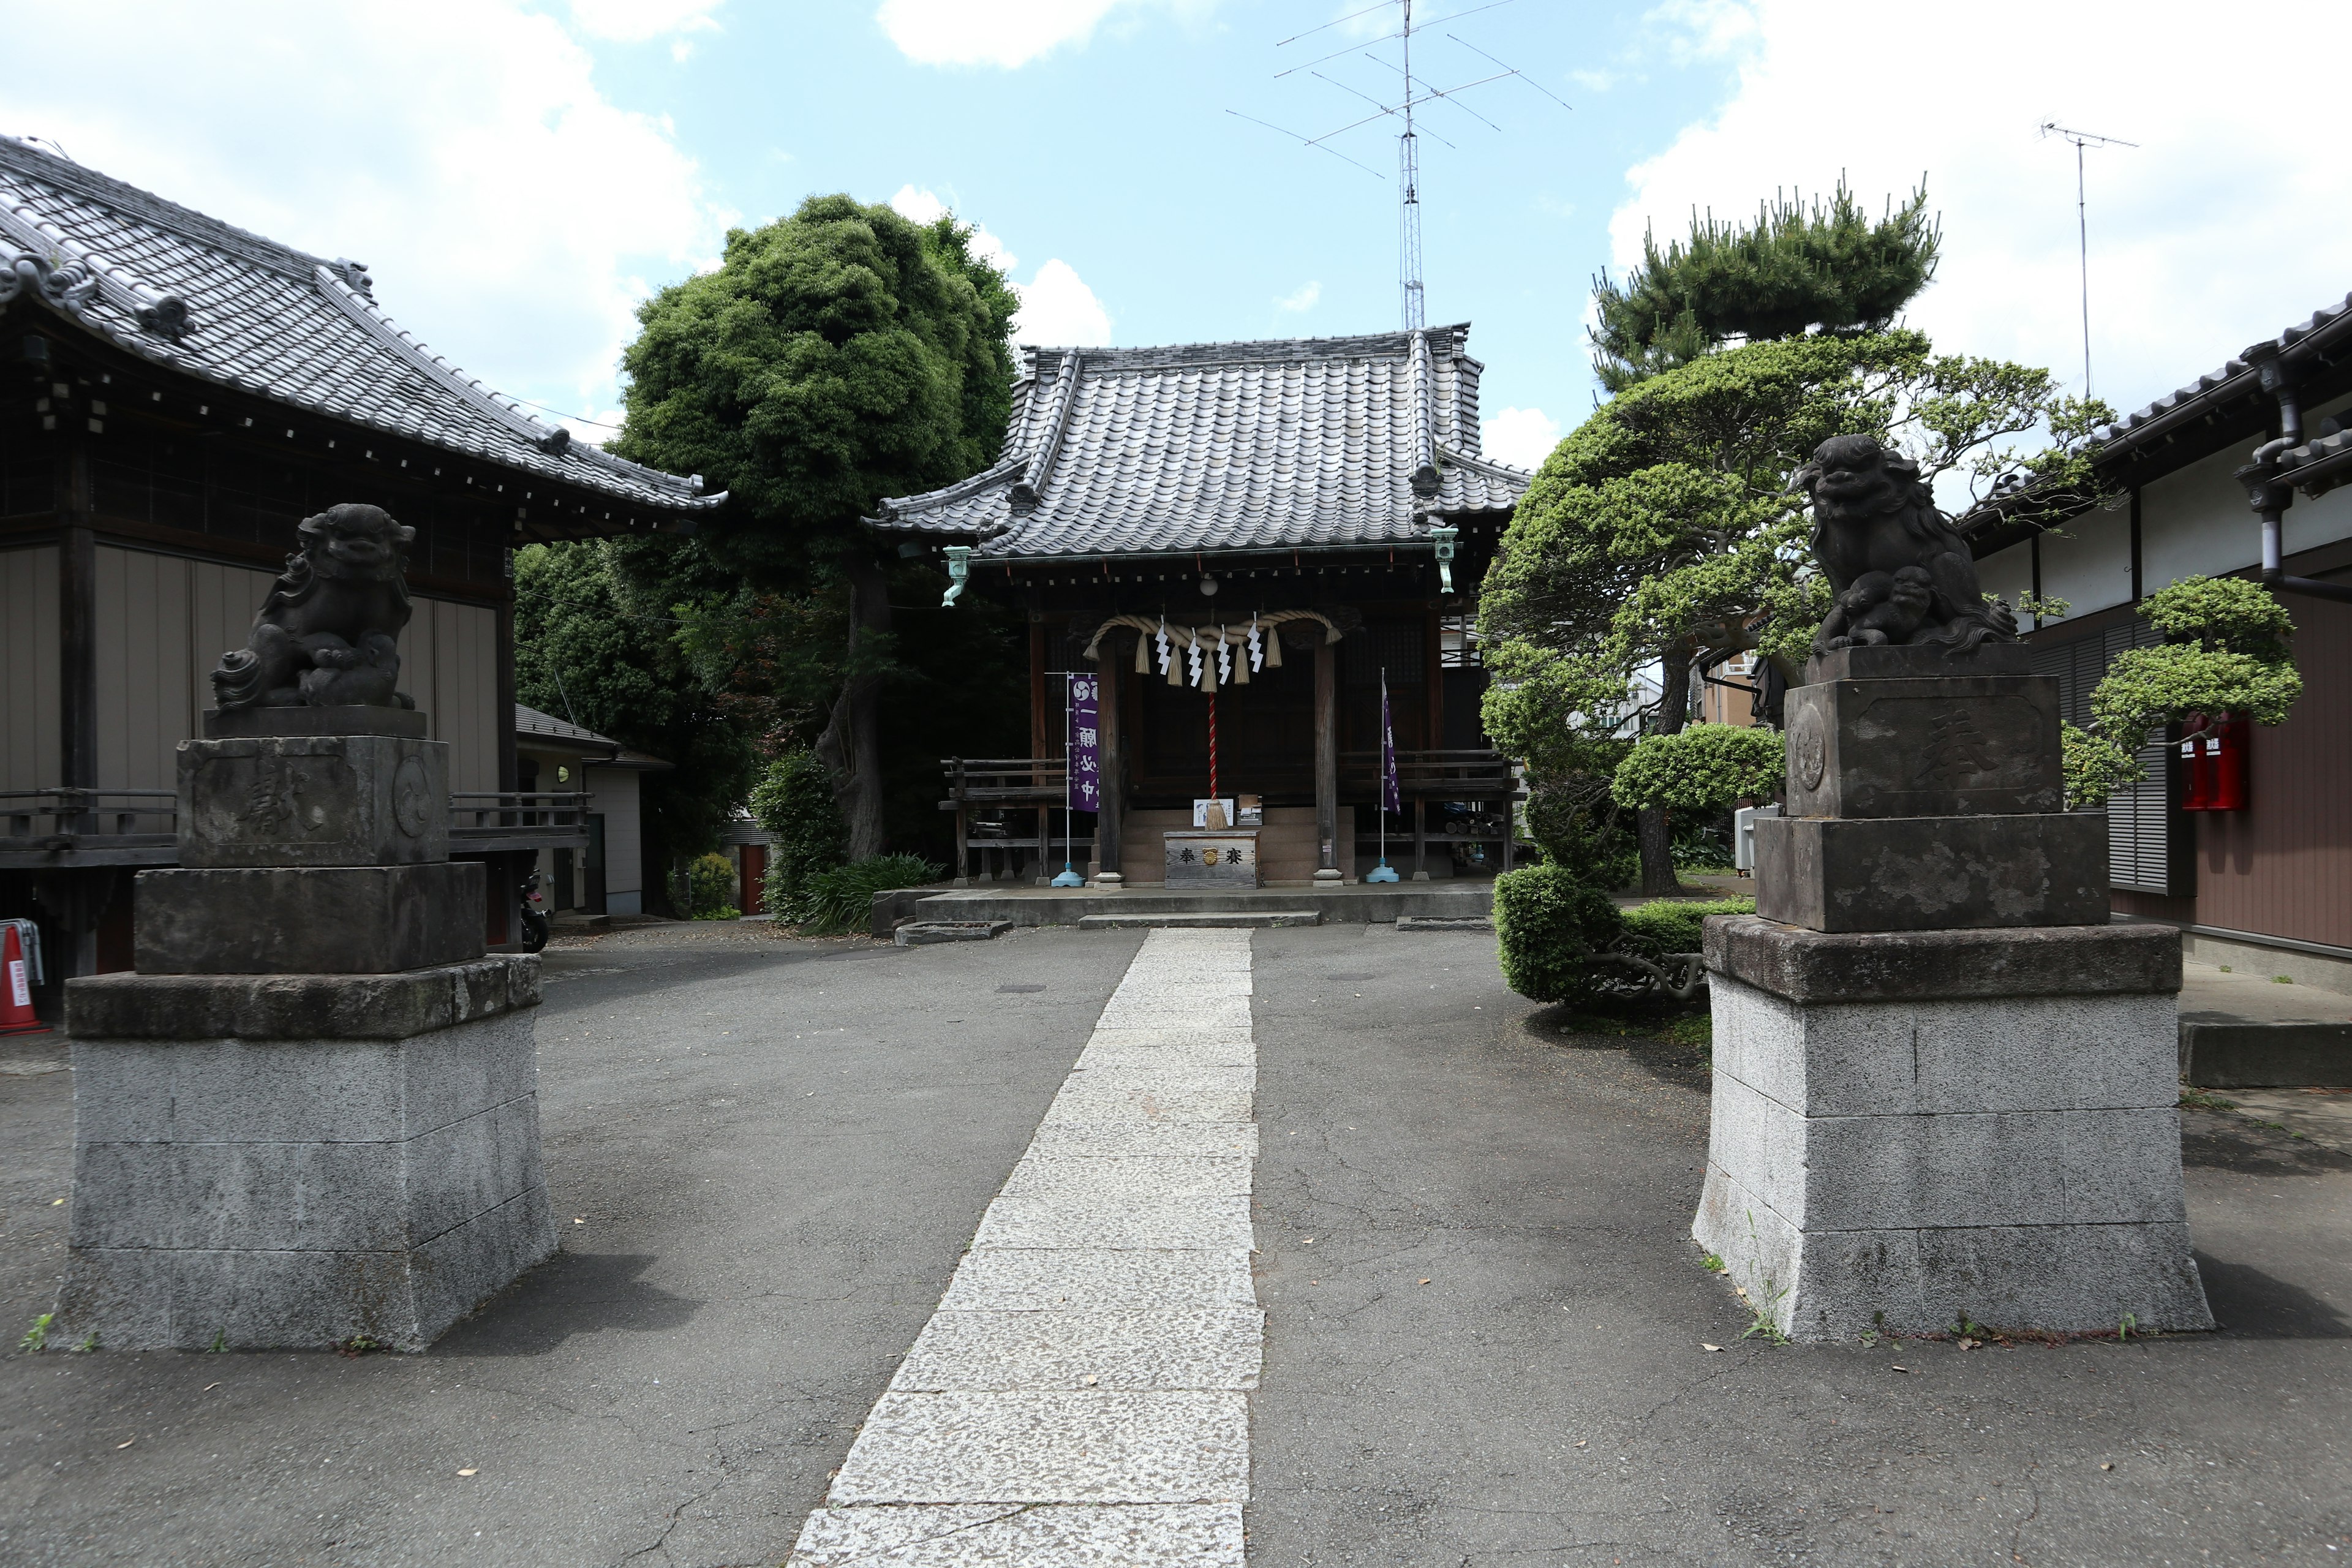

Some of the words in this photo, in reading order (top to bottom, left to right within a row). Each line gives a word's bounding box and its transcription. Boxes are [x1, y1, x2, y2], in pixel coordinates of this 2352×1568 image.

[1915, 701, 1999, 788] 奉
[2181, 741, 2193, 753] 消火器
[2206, 738, 2219, 750] 消火器
[1180, 848, 1195, 865] 奉
